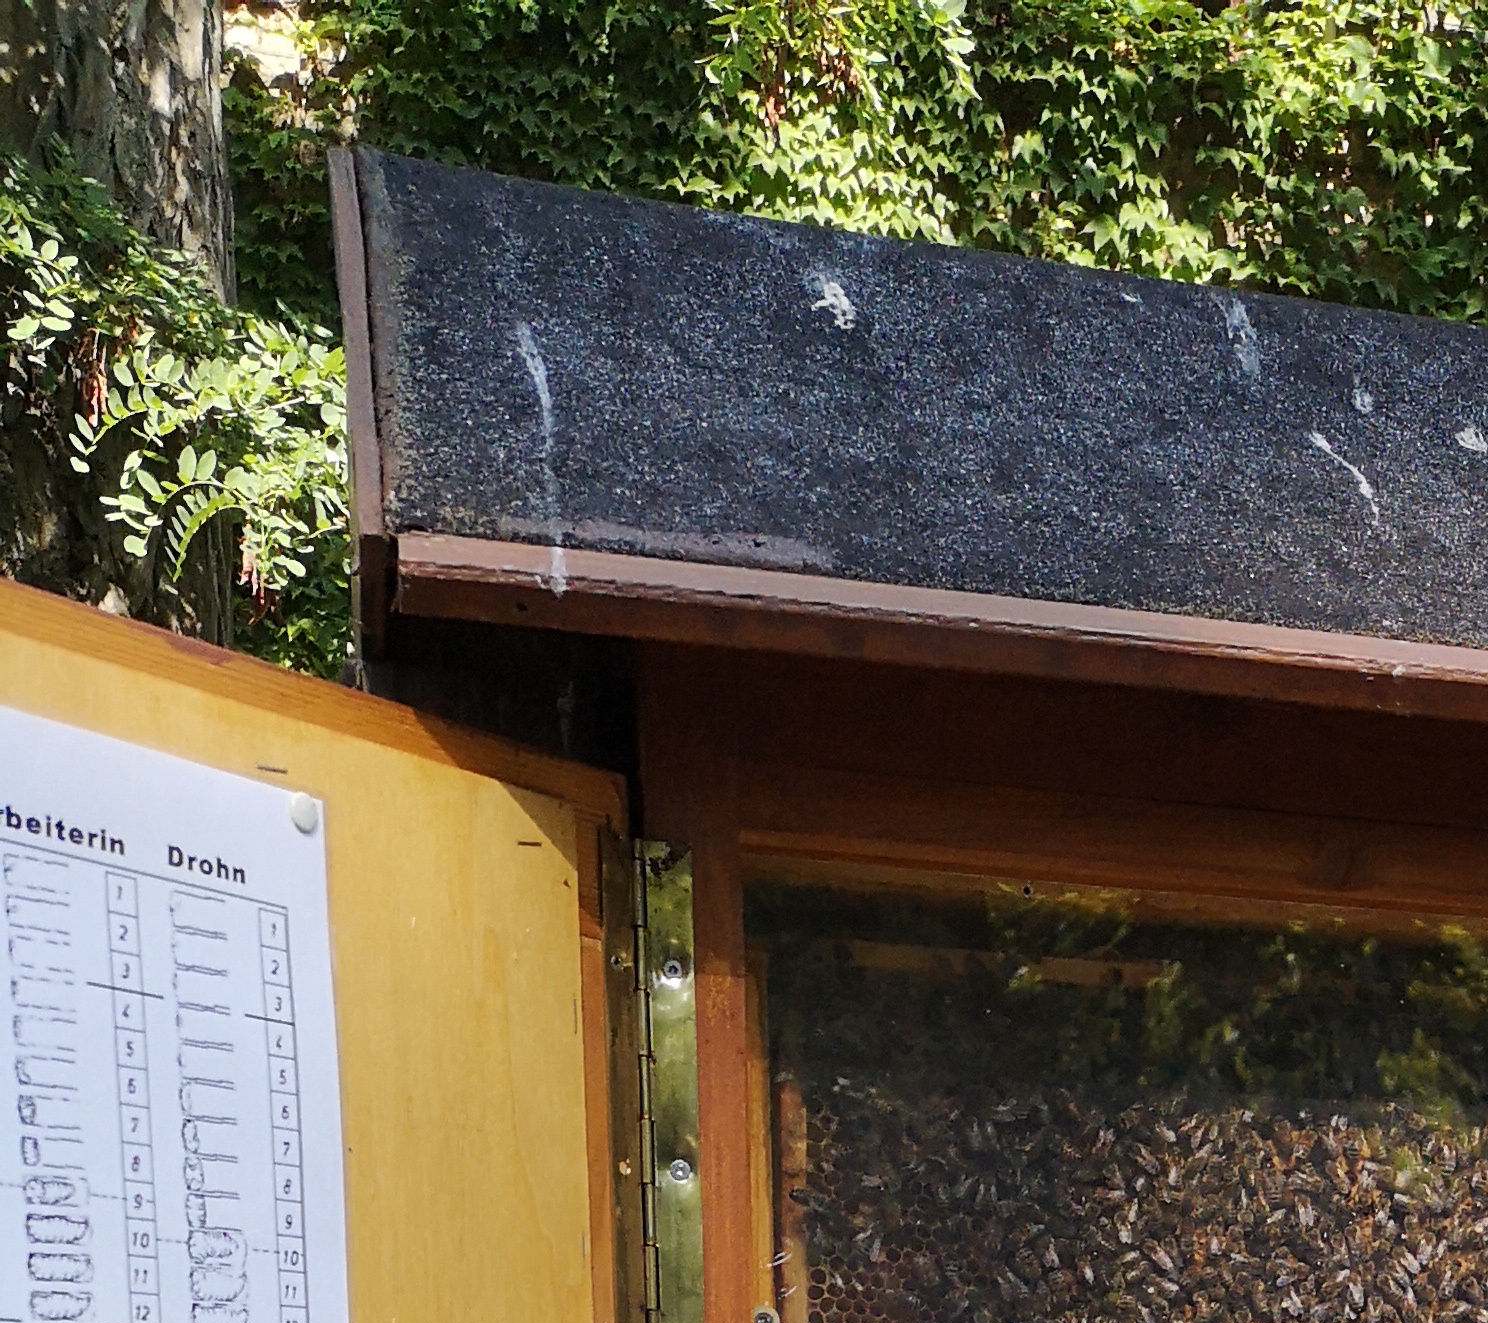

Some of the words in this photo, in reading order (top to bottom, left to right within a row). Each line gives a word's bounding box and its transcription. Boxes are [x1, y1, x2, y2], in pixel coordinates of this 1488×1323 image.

[167, 844, 247, 884] Drohn
[118, 924, 128, 942] 2
[121, 963, 130, 979] 3
[271, 959, 280, 975] 2
[122, 1004, 130, 1018] 4
[274, 996, 282, 1012] 3
[126, 1041, 135, 1058] 5
[279, 1069, 287, 1085] 5
[128, 1078, 136, 1094] 6
[281, 1105, 290, 1120] 6
[131, 1117, 139, 1133] 7
[283, 1141, 290, 1156] 7
[132, 1155, 141, 1172] 8
[283, 1178, 292, 1195] 8
[133, 1194, 143, 1209] 9
[284, 1215, 294, 1230] 9
[132, 1232, 150, 1248] 10
[283, 1250, 299, 1265] 10
[133, 1269, 148, 1284] 11
[284, 1284, 298, 1299] 11
[135, 1306, 150, 1321] 12
